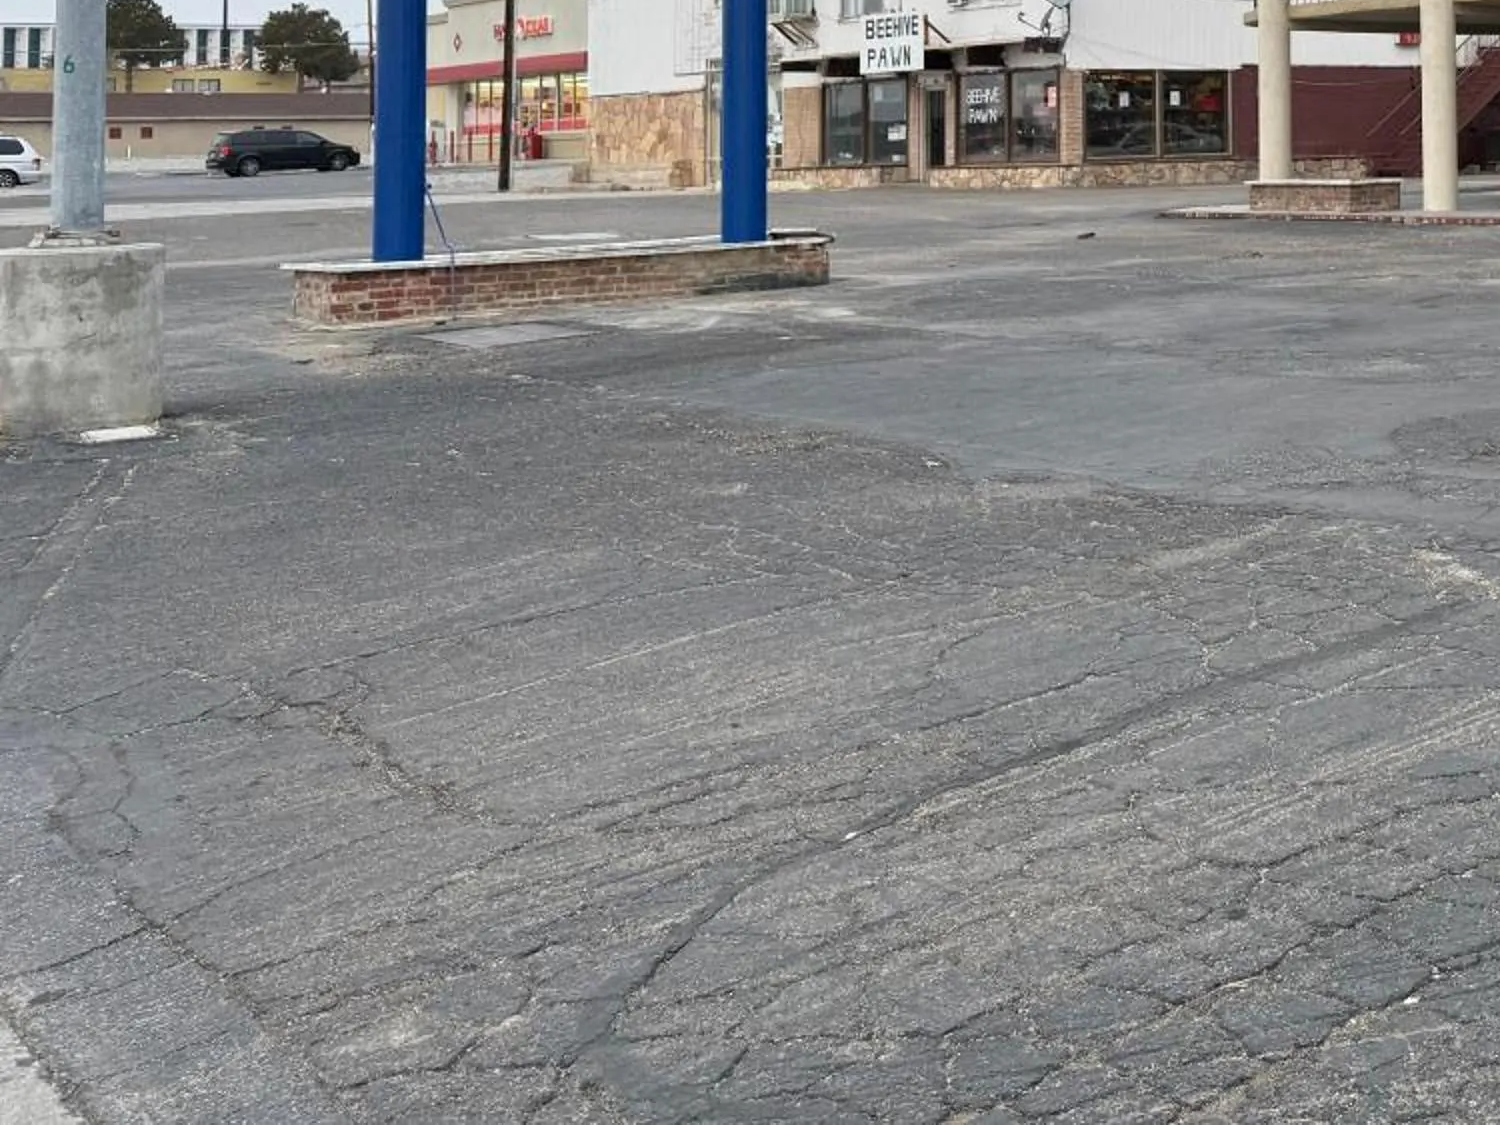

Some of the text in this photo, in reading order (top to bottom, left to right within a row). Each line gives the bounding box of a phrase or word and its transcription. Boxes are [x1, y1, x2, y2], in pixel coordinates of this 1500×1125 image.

[865, 15, 919, 39] BEEHIVE
[63, 54, 75, 74] 6
[867, 45, 911, 67] PAWN
